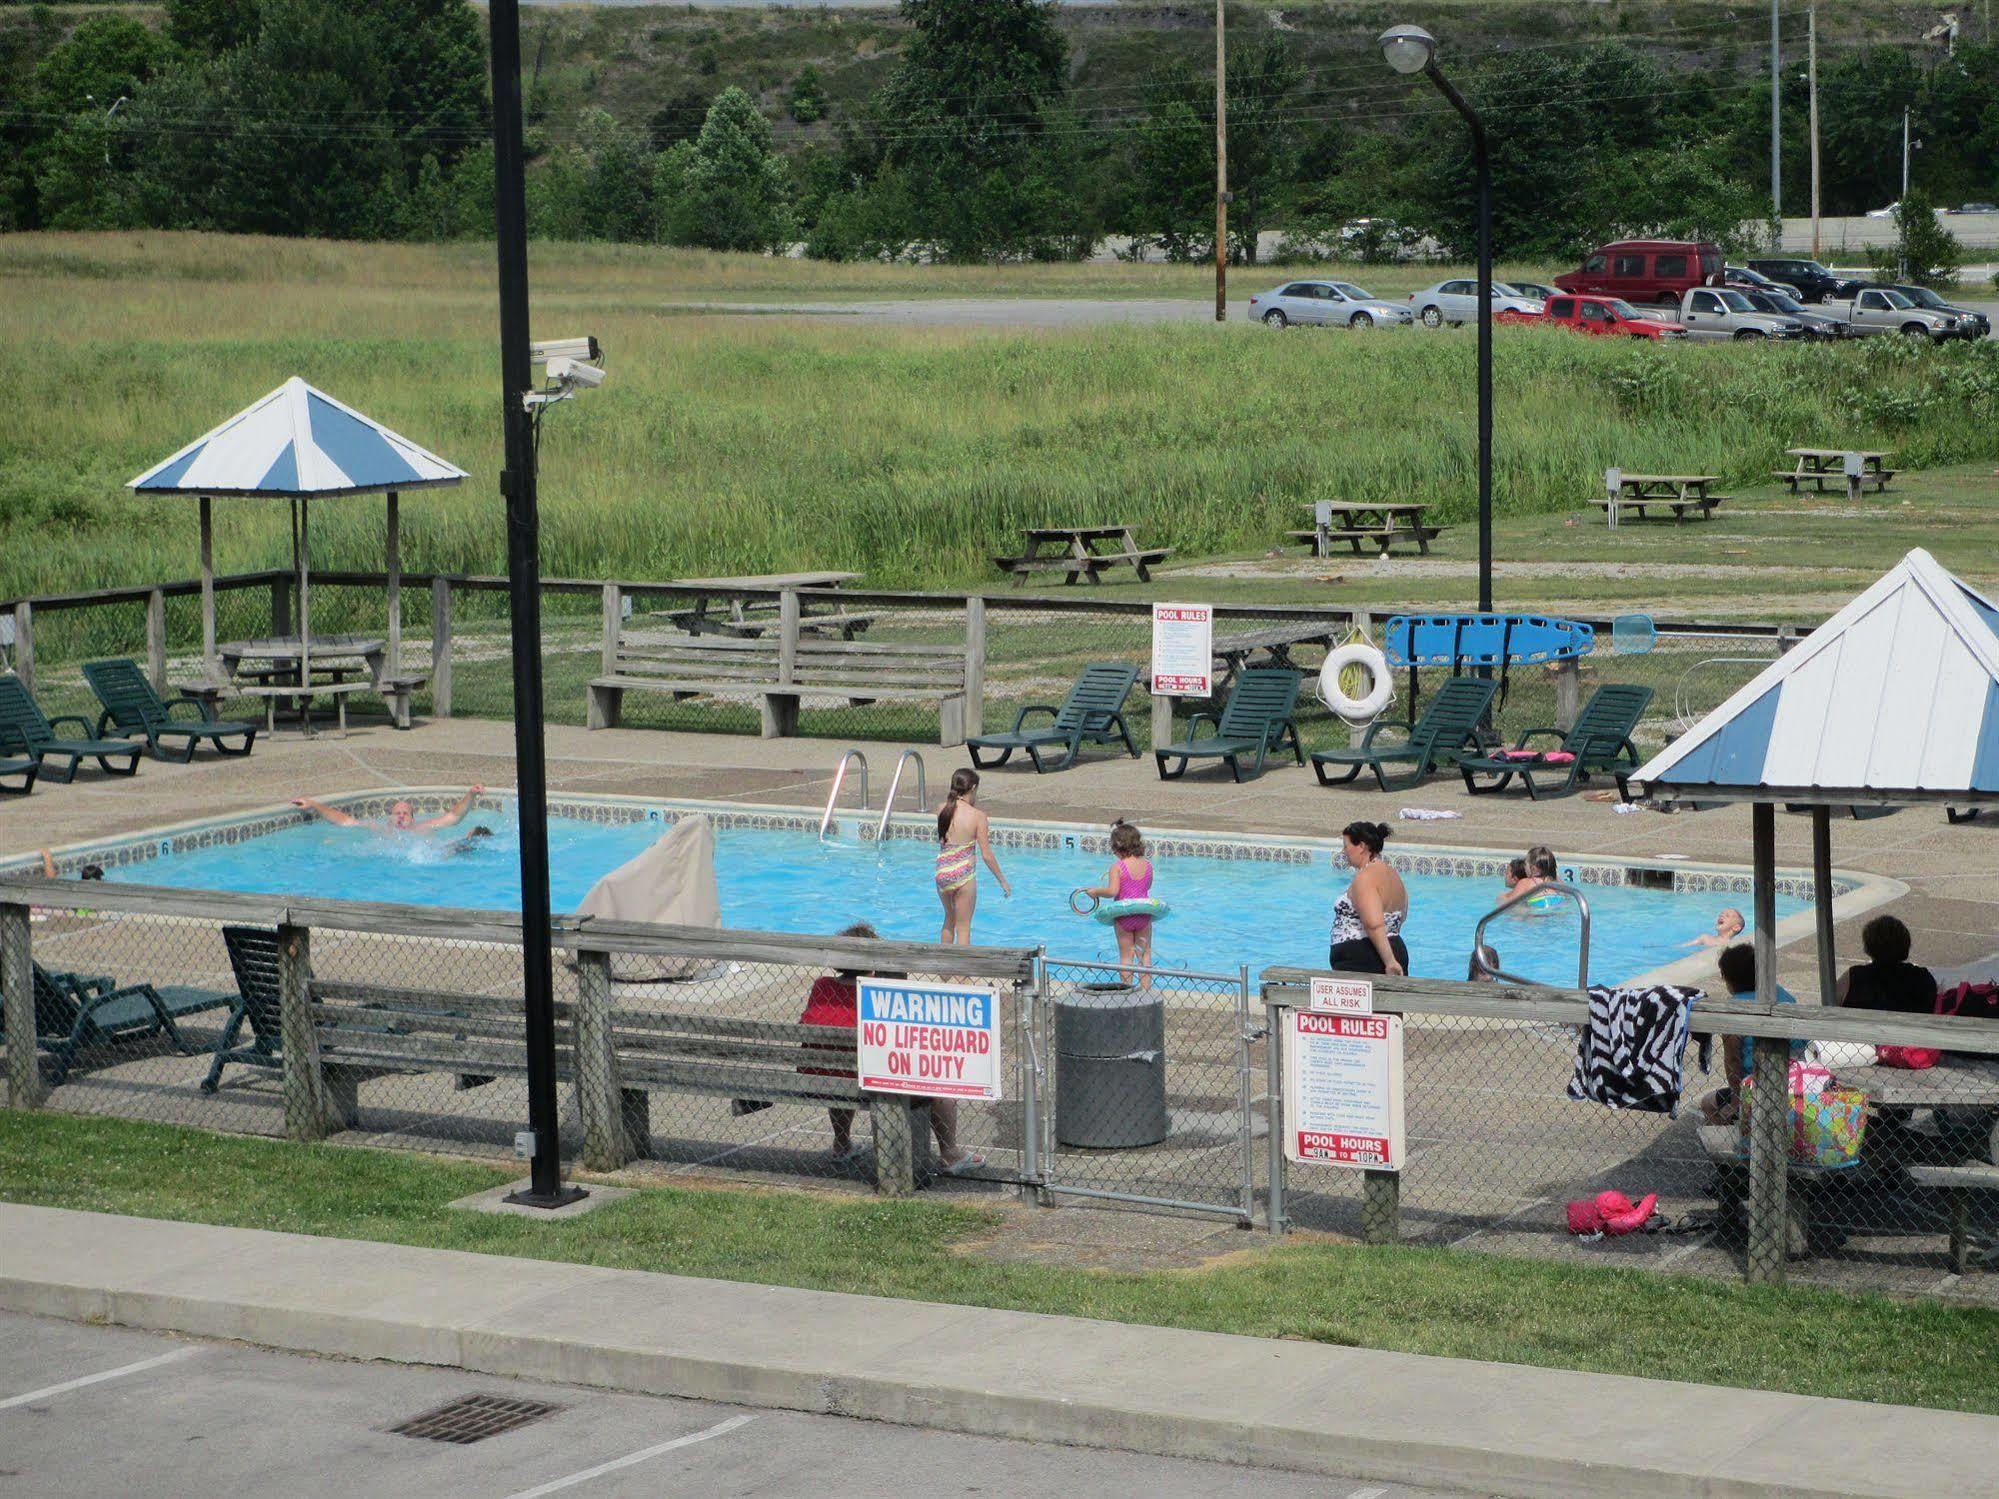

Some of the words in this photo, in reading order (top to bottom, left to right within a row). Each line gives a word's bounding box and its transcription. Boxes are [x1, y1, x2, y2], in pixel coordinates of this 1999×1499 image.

[1158, 610, 1179, 620] POOL
[1181, 610, 1206, 621] RULES
[1158, 676, 1177, 685] POOL
[1179, 676, 1202, 685] HOURS
[161, 842, 169, 854] 6
[1065, 837, 1075, 848] 5
[1564, 869, 1574, 882] 3
[1315, 984, 1333, 995] USER
[1335, 985, 1367, 997] ASSUMES
[870, 990, 983, 1025] WARNING
[1322, 997, 1339, 1007] ALL
[1340, 998, 1361, 1008] RISK
[1299, 1015, 1336, 1033] POOL
[1340, 1018, 1385, 1037] RULES
[863, 1022, 887, 1047] NO
[894, 1025, 990, 1055] LIFEGUARD
[887, 1051, 911, 1075] ON
[918, 1054, 966, 1080] DUTY
[1303, 1134, 1336, 1148] POOL
[1340, 1137, 1382, 1152] HOURS
[1313, 1147, 1329, 1159] 9AM
[1339, 1151, 1348, 1159] TO
